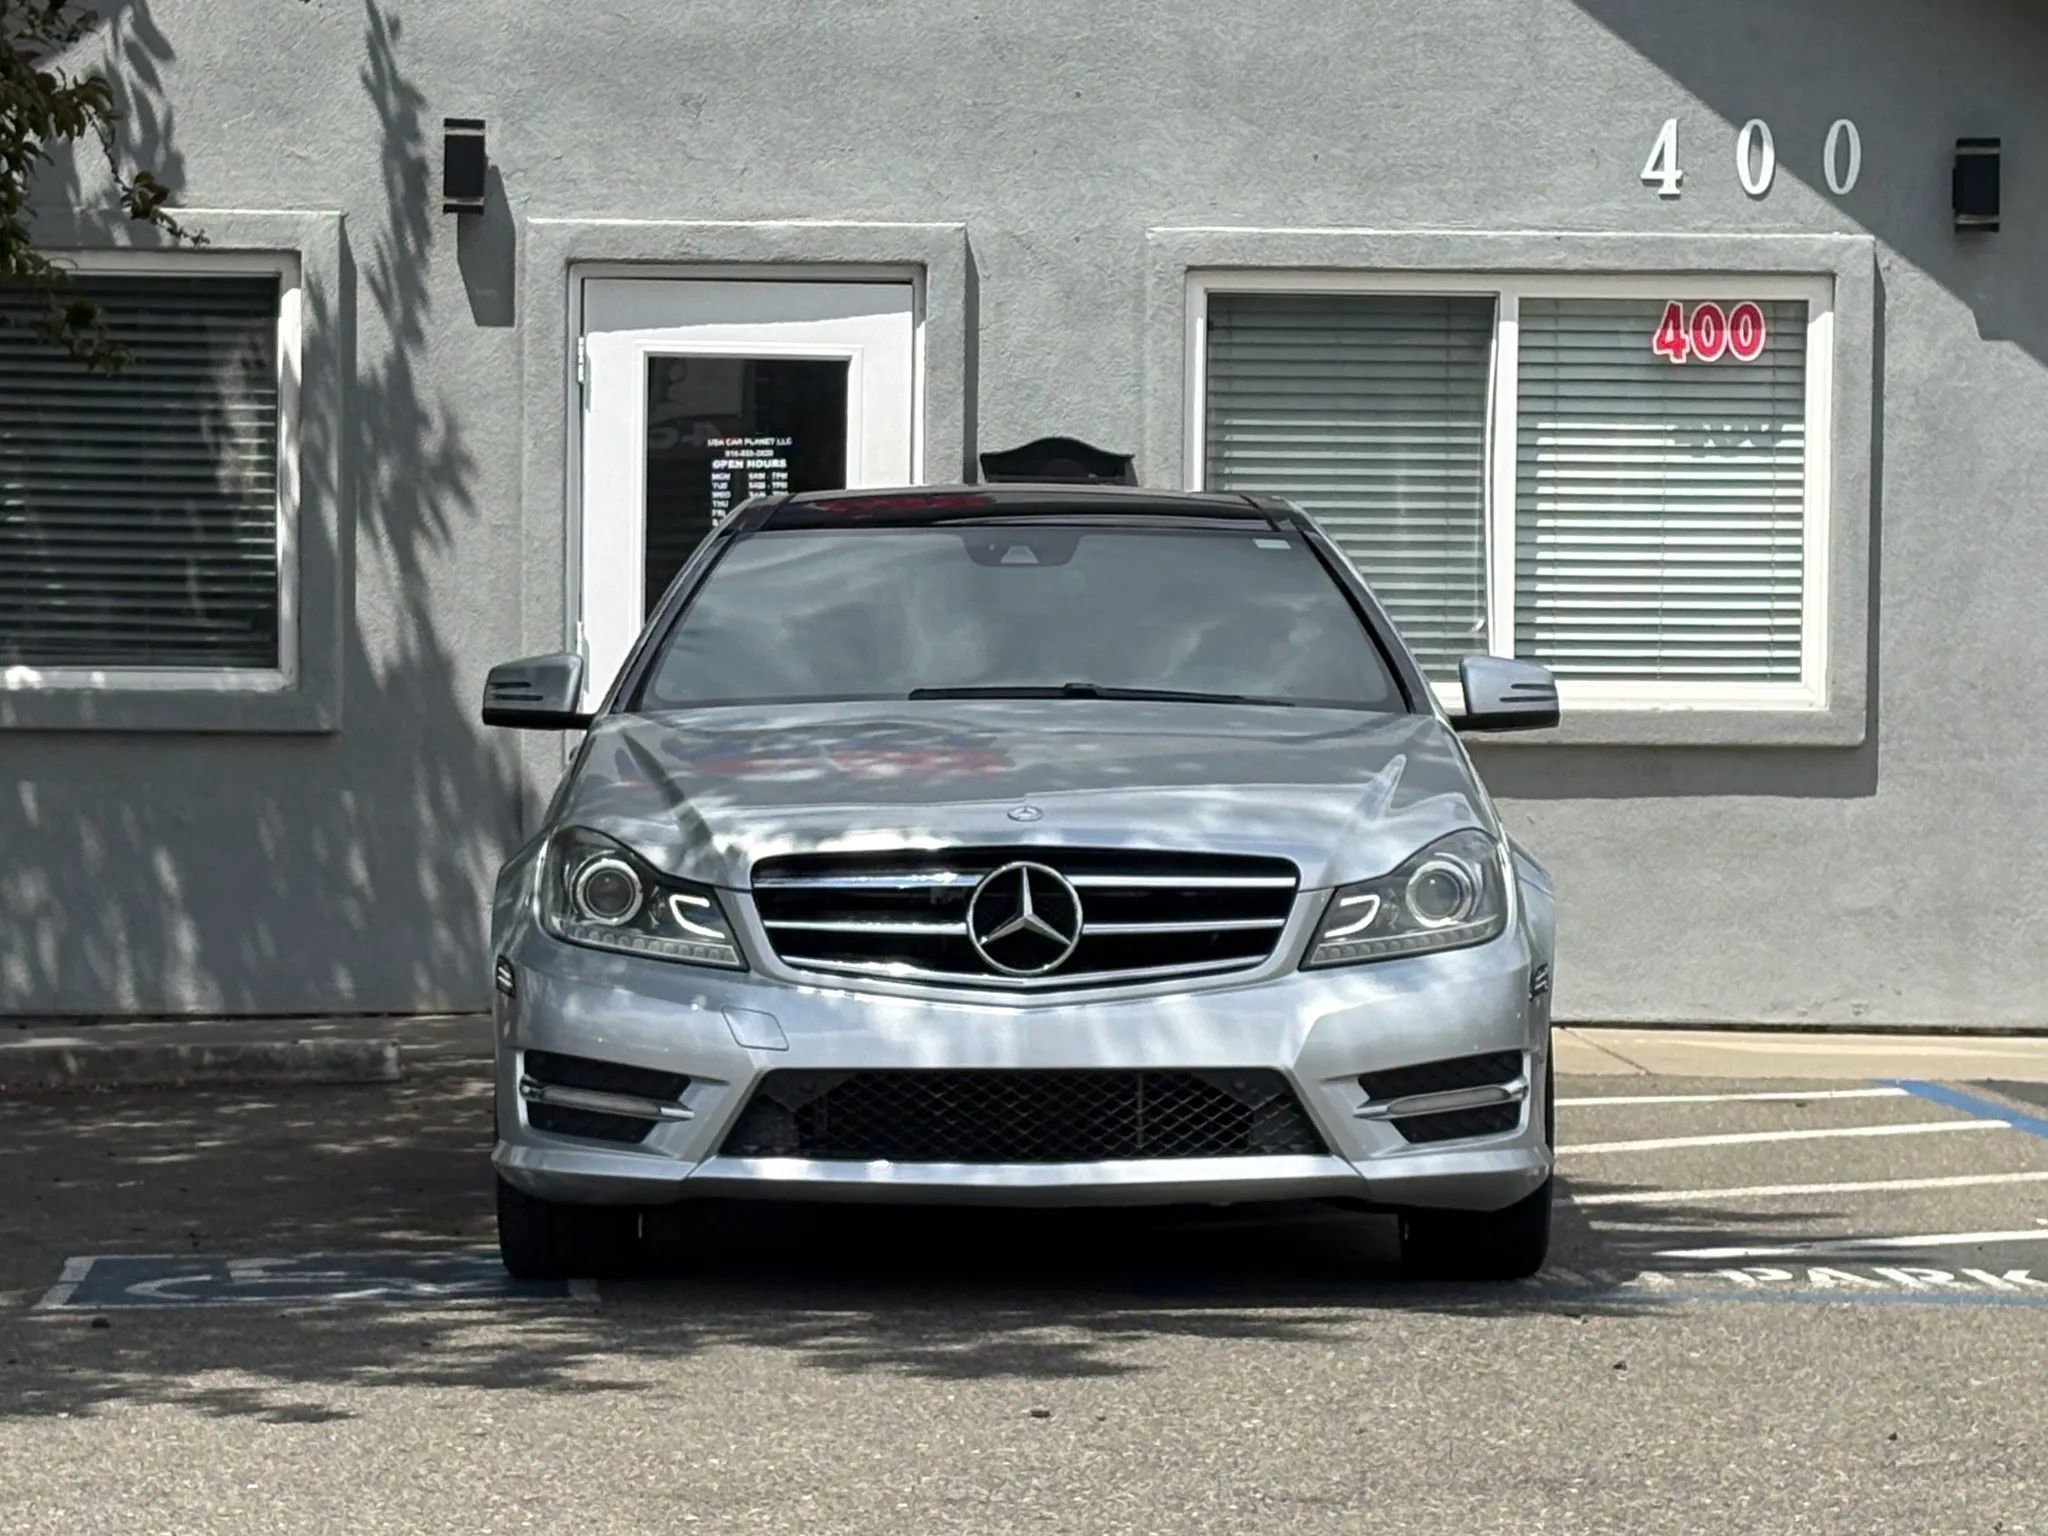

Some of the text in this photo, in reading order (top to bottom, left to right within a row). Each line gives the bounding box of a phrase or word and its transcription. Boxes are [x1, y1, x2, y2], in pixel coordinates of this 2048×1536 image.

[1653, 300, 1766, 363] 400
[712, 459, 787, 469] OPEN HOURS
